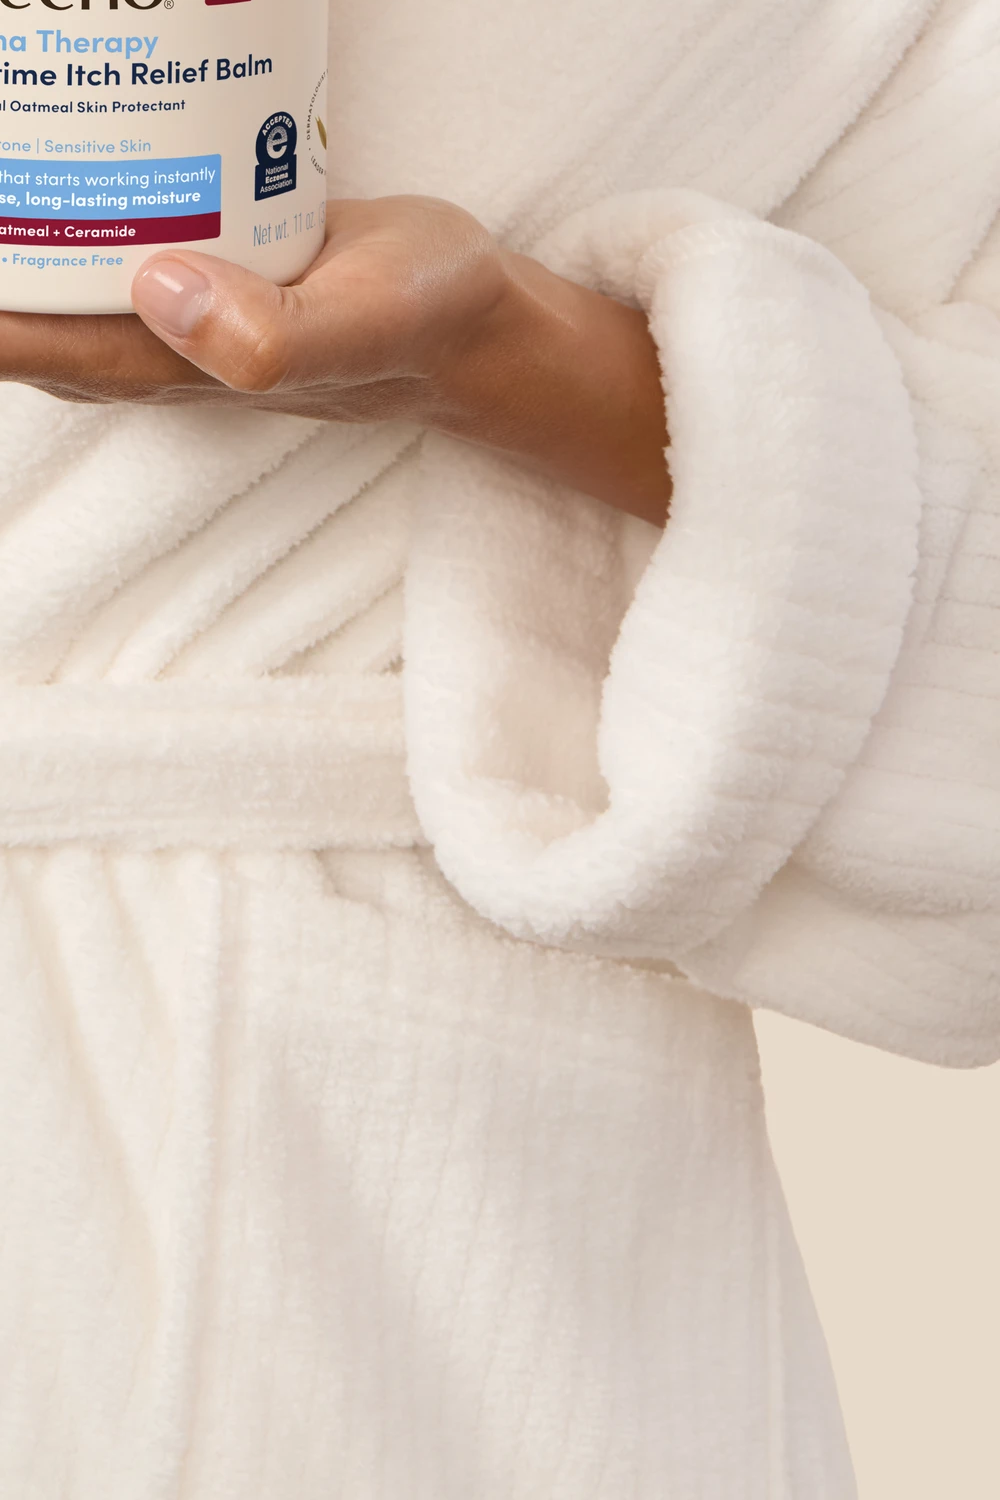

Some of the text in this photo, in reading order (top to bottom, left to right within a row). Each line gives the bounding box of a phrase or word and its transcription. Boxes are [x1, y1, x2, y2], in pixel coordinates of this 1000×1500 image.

[36, 29, 159, 59] Therapy
[67, 62, 121, 86] Itch
[131, 59, 209, 85] Relief
[216, 53, 273, 81] Balm
[10, 100, 73, 113] Oatmeal
[77, 101, 108, 113] Skin
[112, 100, 186, 113] Protectant
[262, 115, 293, 136] ACCEPTED
[44, 139, 116, 153] Sensitive
[119, 139, 152, 153] Skin
[35, 172, 80, 187] starts
[85, 172, 150, 189] working
[153, 166, 216, 184] instantly
[265, 162, 289, 177] National
[259, 178, 293, 194] Association
[265, 173, 289, 184] Eczema
[25, 191, 128, 211] long-lasting
[132, 191, 201, 206] moisture
[64, 225, 137, 238] Ceramide
[253, 222, 272, 247] Net
[275, 218, 290, 240] wt.
[293, 213, 303, 235] 11
[306, 211, 317, 231] oz.
[12, 253, 88, 270] Fragrance
[91, 254, 124, 267] Free
